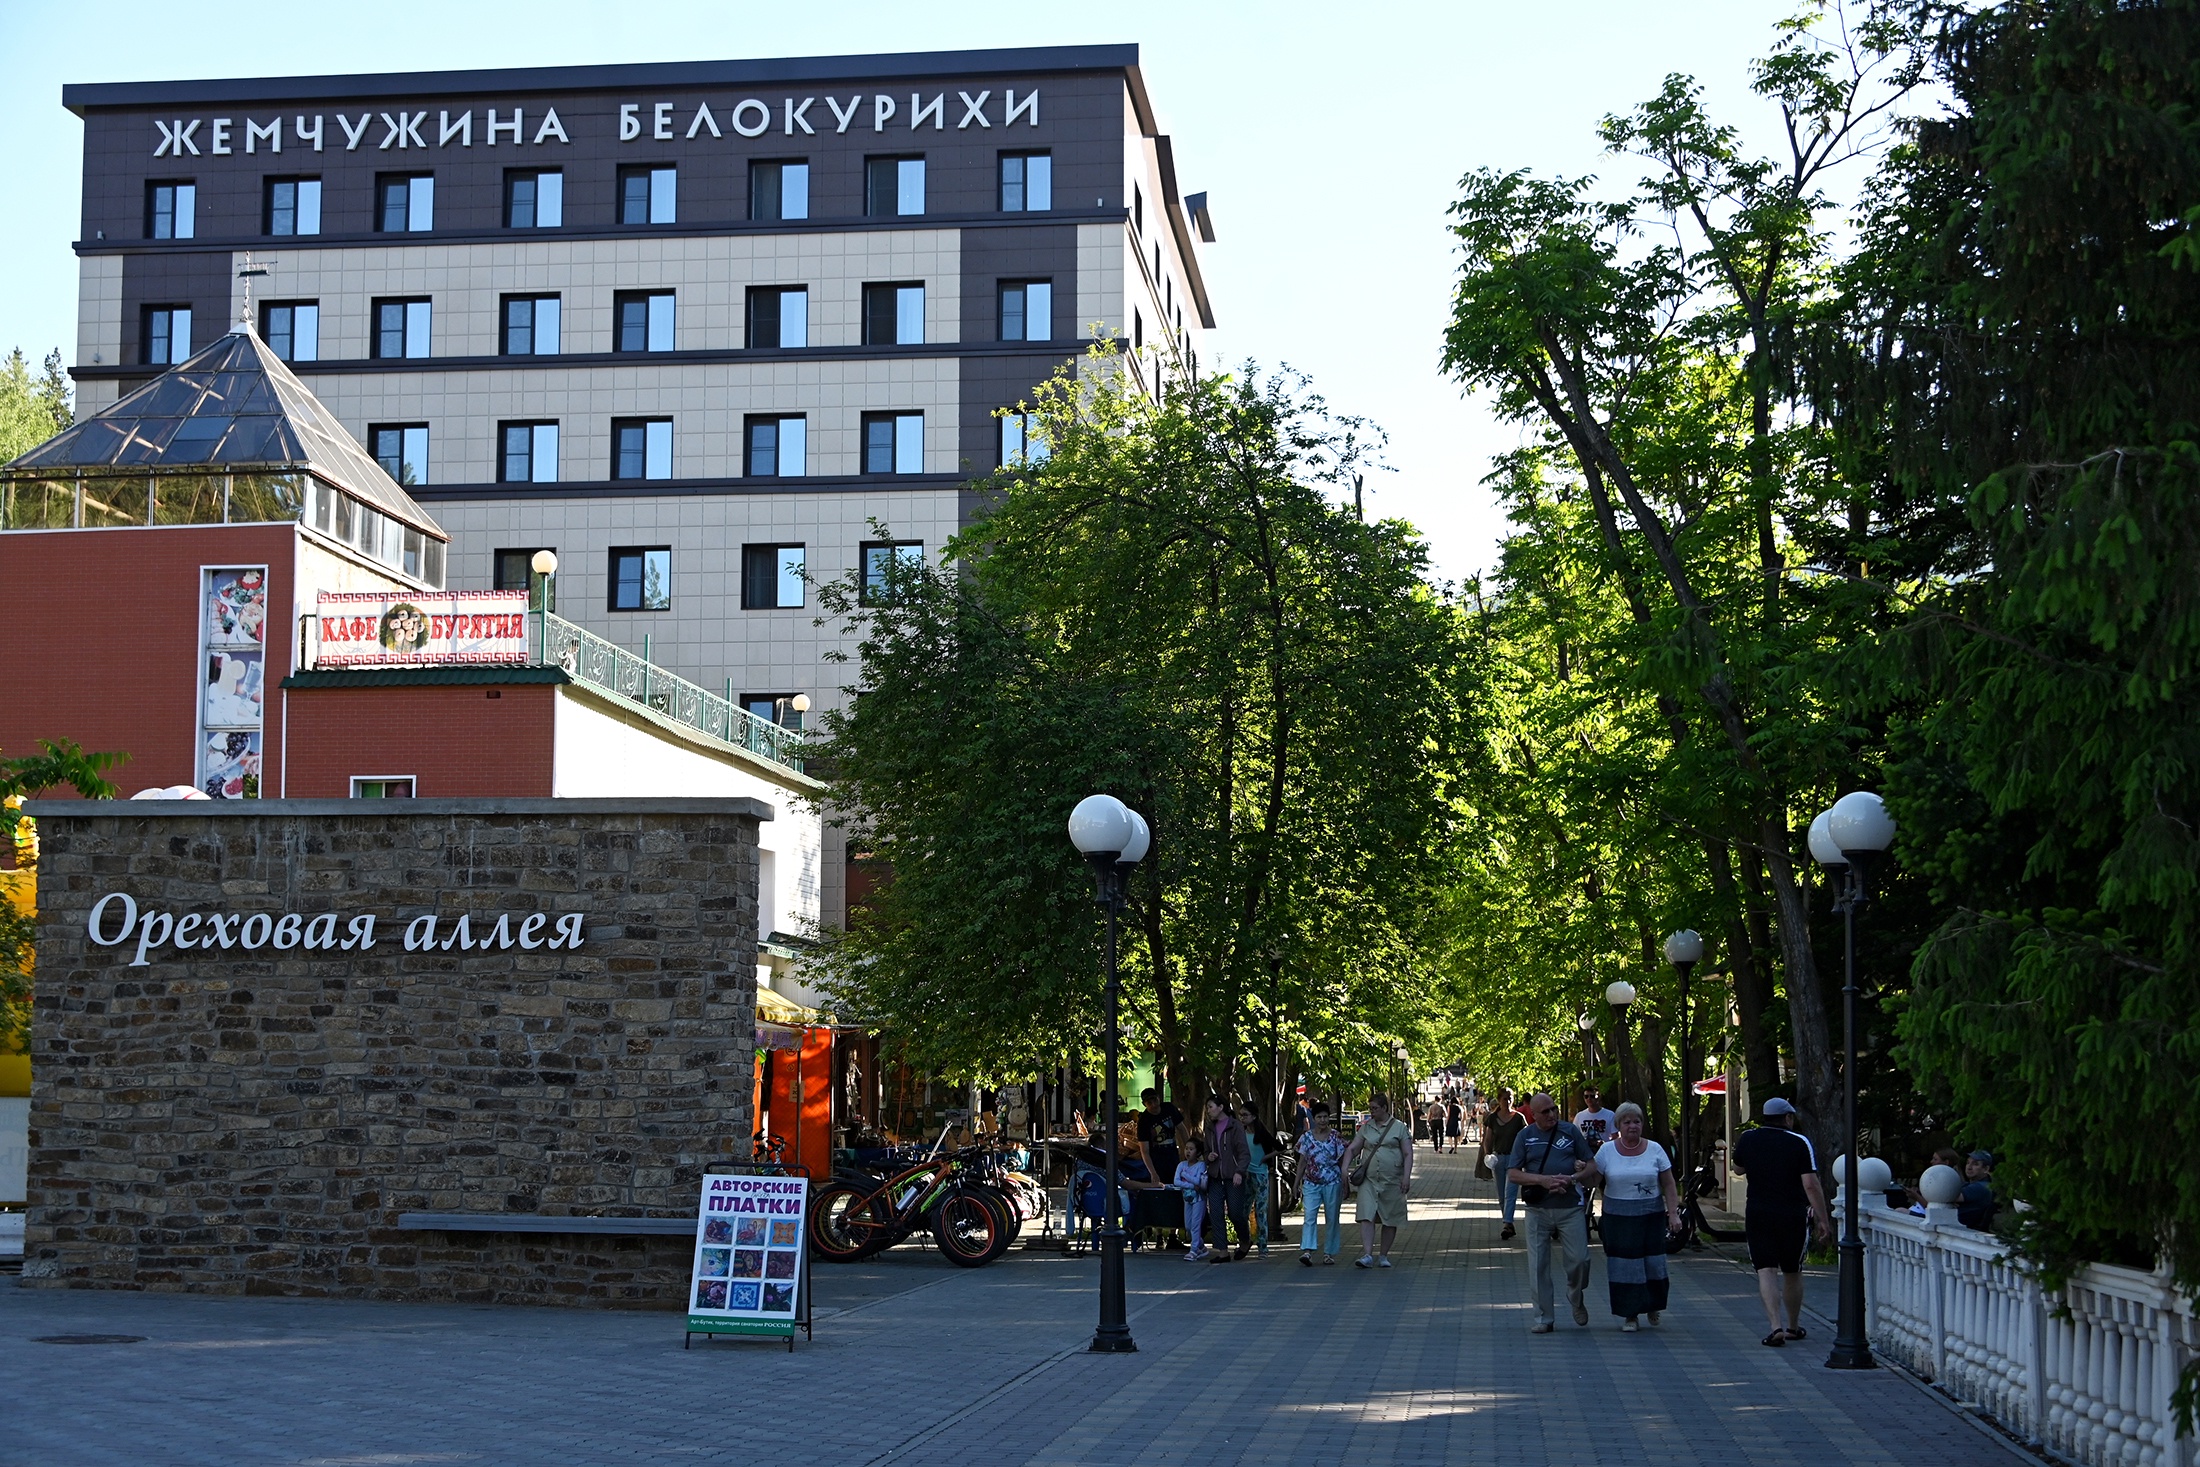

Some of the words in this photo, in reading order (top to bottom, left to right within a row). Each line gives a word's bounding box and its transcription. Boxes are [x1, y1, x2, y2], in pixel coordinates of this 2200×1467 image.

[152, 106, 570, 158] ЖЕМЧУЖИНА
[619, 88, 1039, 142] БЕЛОКУРИХИ
[321, 616, 378, 642] КАФЕ
[430, 613, 524, 639] БУРЯТИЯ
[88, 892, 377, 967] Ореховая
[403, 912, 585, 951] аллея
[710, 1179, 802, 1194] АВТОРСКИЕ
[708, 1196, 800, 1214] ПЛАТКИ
